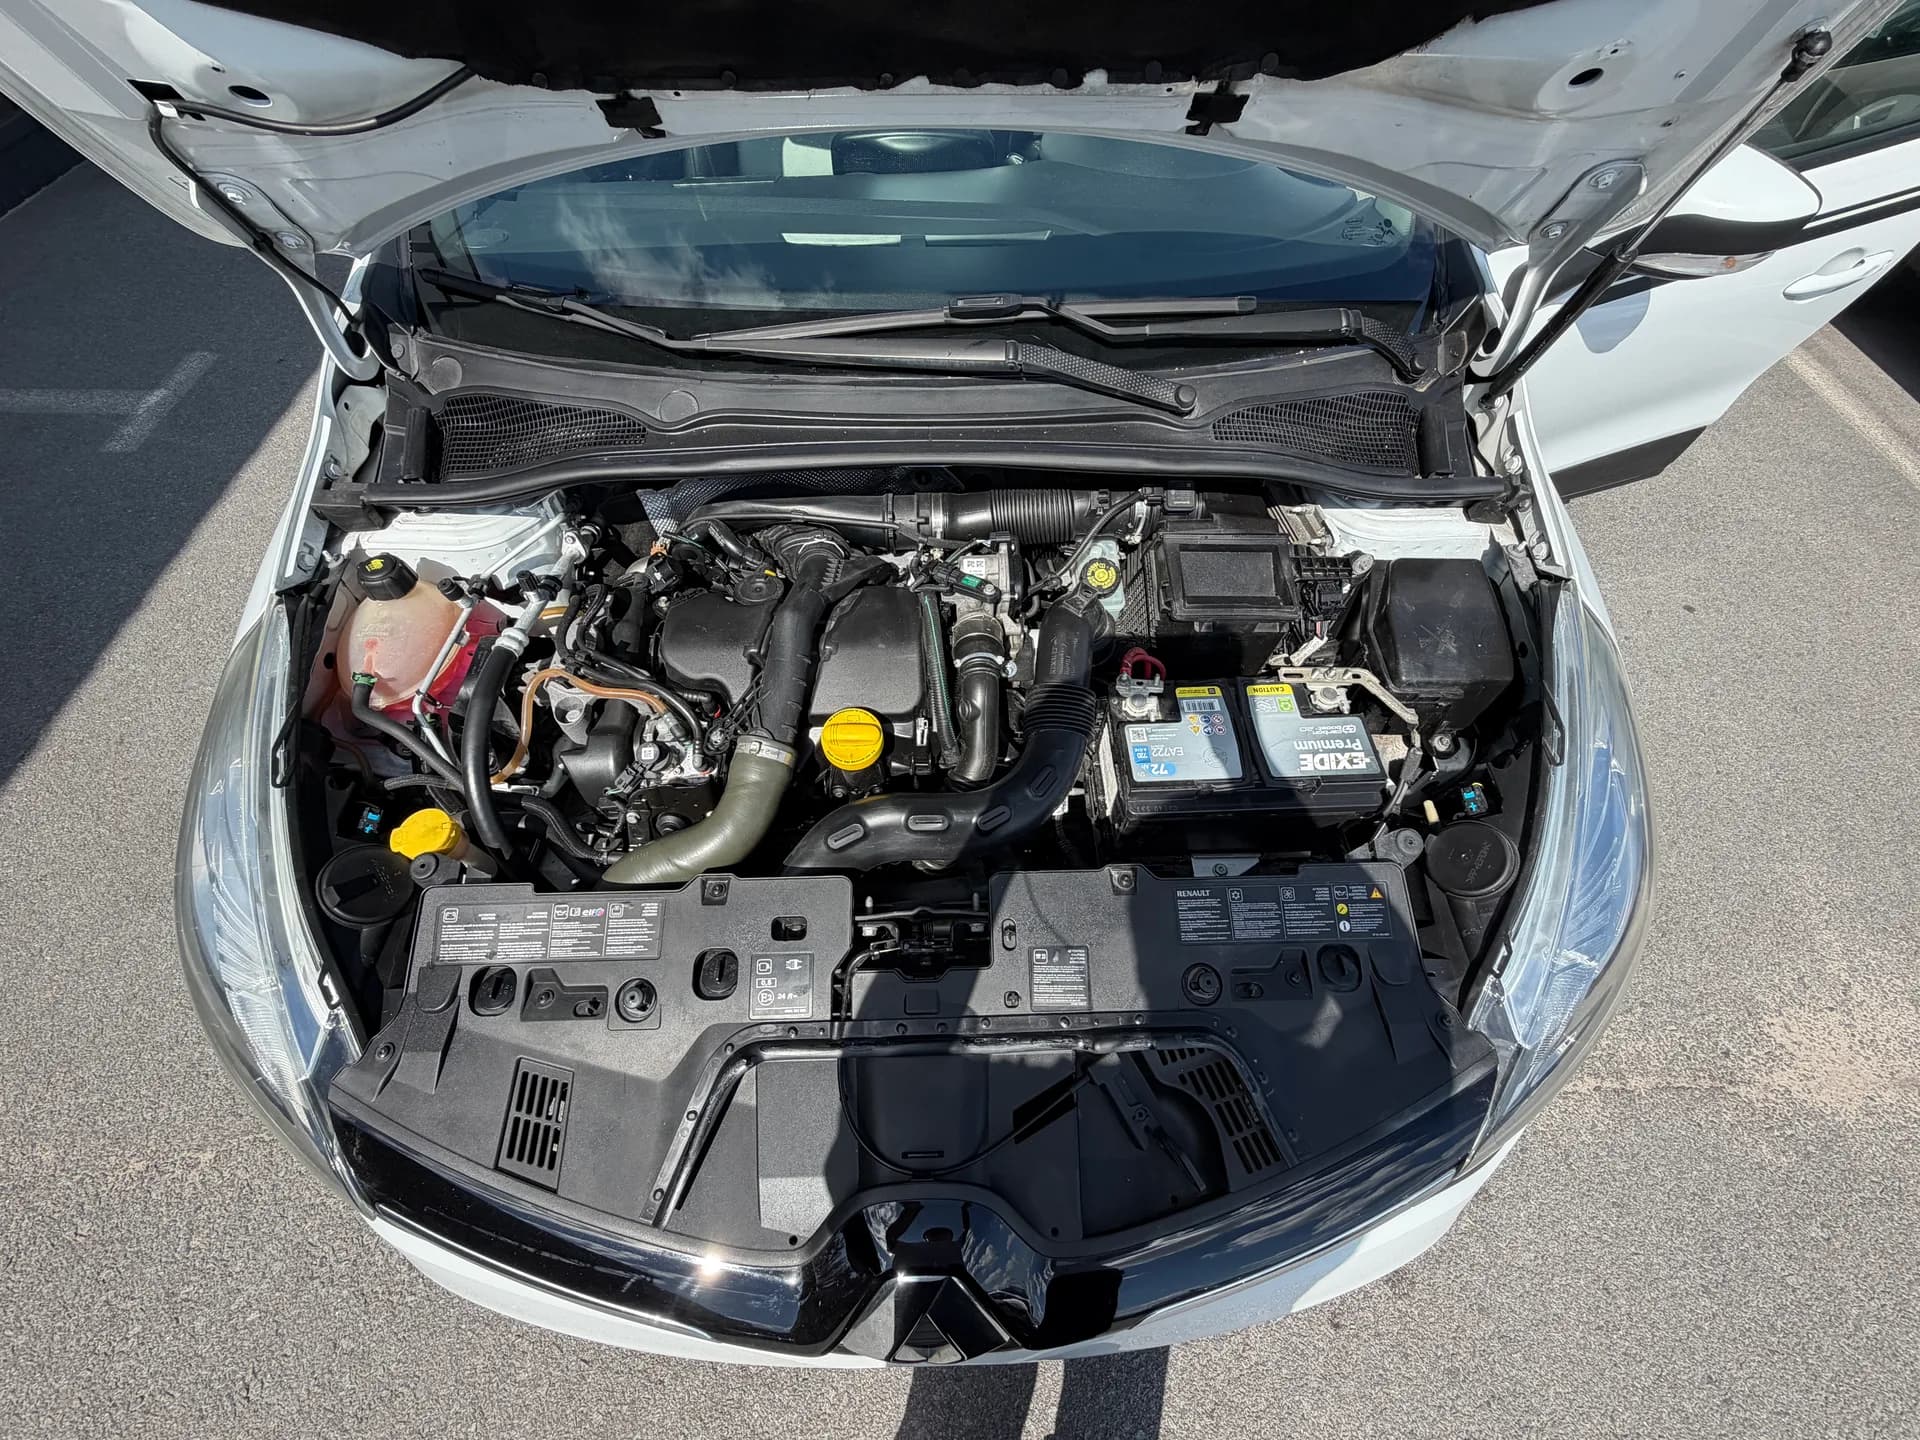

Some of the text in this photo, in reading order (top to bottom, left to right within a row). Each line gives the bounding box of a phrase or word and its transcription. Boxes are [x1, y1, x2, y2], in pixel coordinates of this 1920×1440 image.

[1293, 738, 1363, 751] Premium
[1151, 746, 1184, 757] EA722
[1299, 752, 1370, 771] EXIDE
[1150, 764, 1168, 775] 72
[1176, 889, 1210, 897] RENAULT
